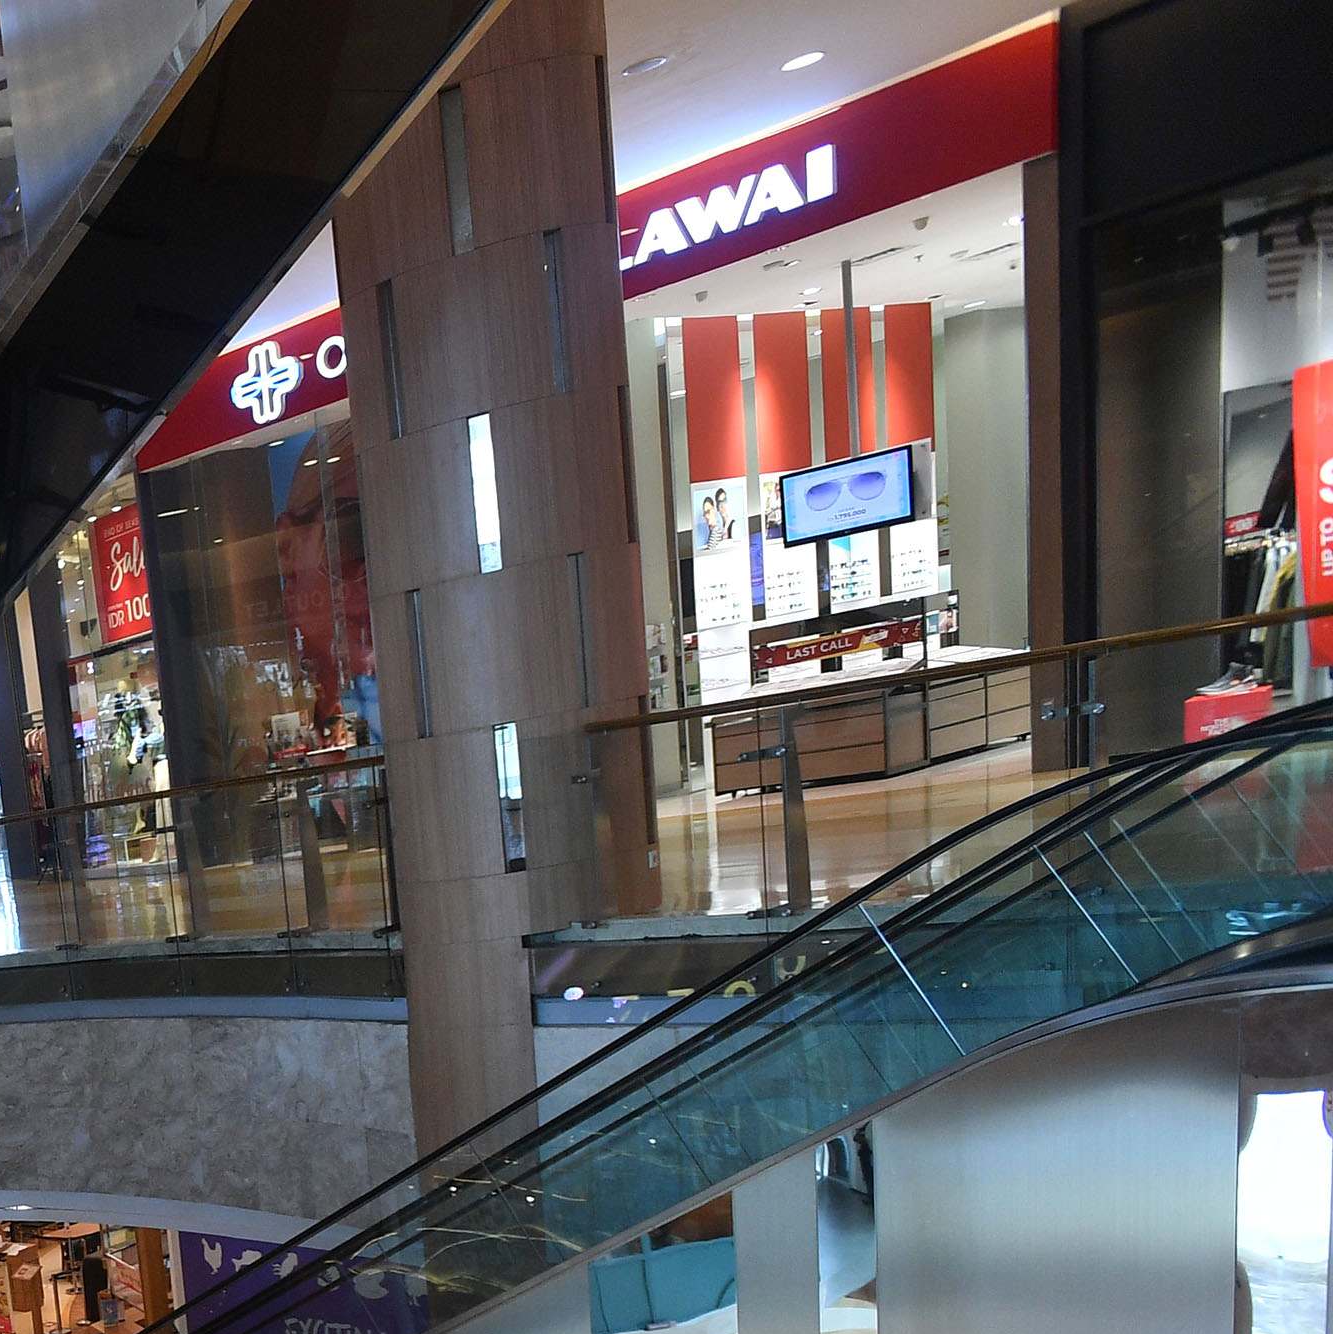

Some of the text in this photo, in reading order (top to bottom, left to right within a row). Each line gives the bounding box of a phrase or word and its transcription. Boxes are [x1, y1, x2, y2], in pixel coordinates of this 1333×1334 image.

[620, 143, 837, 272] AWAI
[125, 517, 140, 530] SEAS
[108, 610, 125, 628] IDR
[786, 646, 816, 661] LAST
[820, 637, 853, 653] CALL
